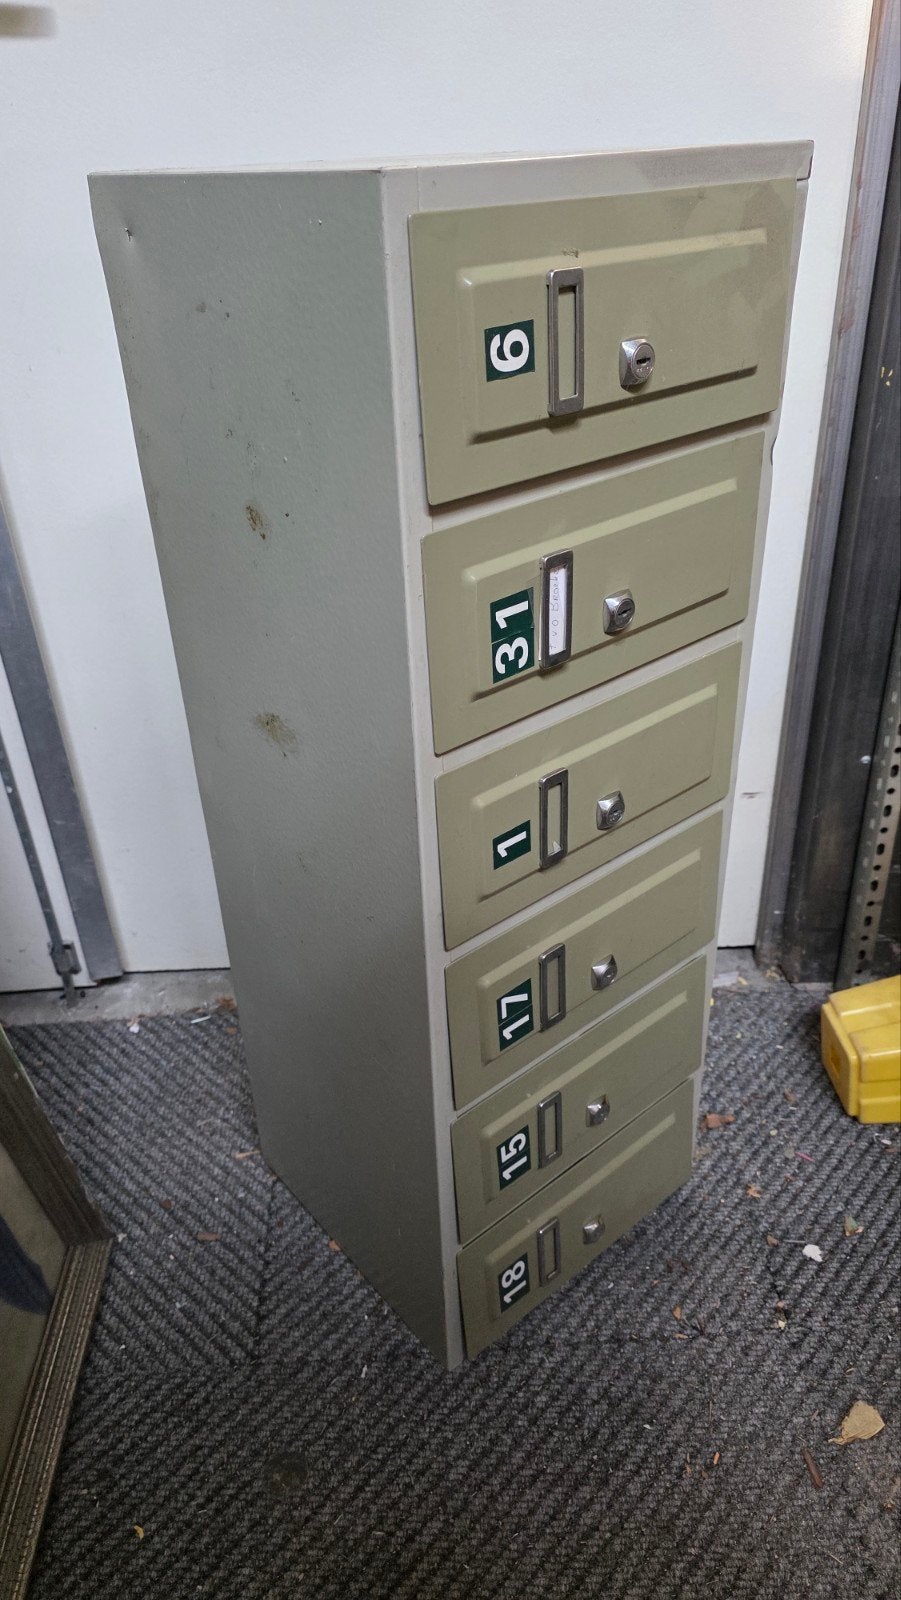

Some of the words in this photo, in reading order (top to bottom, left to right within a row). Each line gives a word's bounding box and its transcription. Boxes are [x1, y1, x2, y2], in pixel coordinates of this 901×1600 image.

[489, 329, 530, 373] 6
[495, 600, 529, 674] 31
[497, 830, 527, 858] 1
[500, 993, 530, 1040] 17
[500, 1133, 528, 1181] 15
[501, 1260, 526, 1303] 18
